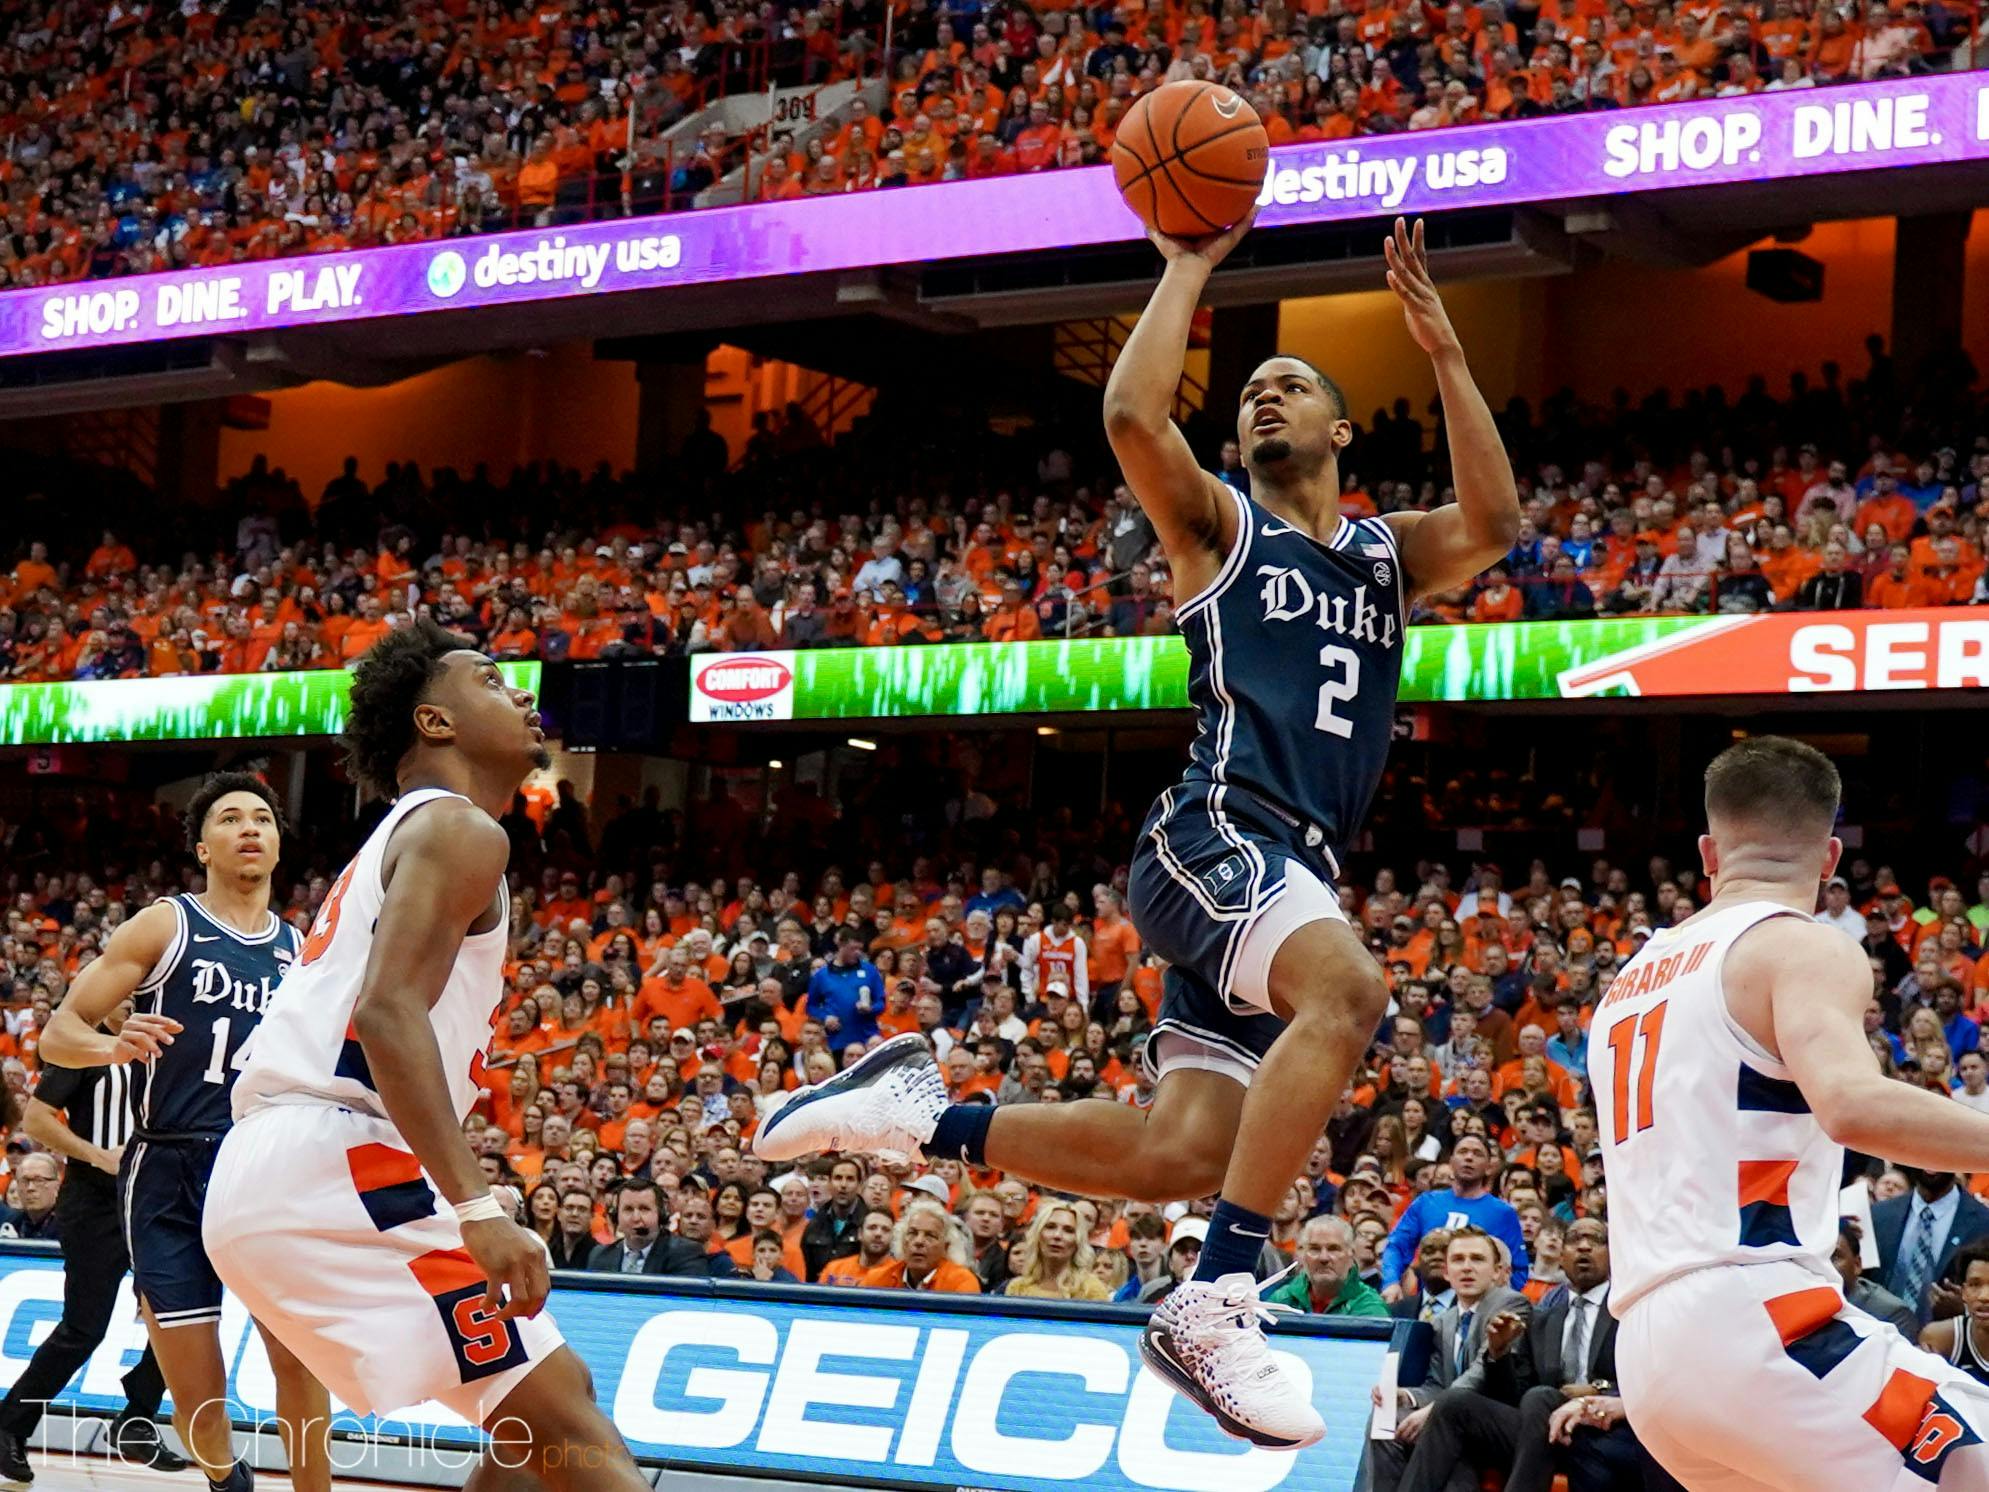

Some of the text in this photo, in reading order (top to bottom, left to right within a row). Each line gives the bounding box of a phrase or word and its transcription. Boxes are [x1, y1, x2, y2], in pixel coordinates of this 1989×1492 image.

[1425, 147, 1507, 189] usa
[1603, 112, 1761, 177] SHOP.
[1793, 94, 1942, 158] DINE.
[474, 235, 681, 288] destiny usa
[41, 263, 362, 339] SHOP. DINE. PLAY.
[1256, 564, 1397, 650] Duke
[705, 666, 781, 692] COMFORT
[1314, 643, 1361, 739] 2
[1788, 619, 1989, 692] SER
[709, 702, 774, 720] WINDOWS
[191, 958, 277, 1015] Duk
[1603, 940, 1717, 1009] GIRARD III
[1607, 998, 1669, 1147] 11
[452, 1293, 512, 1367] S
